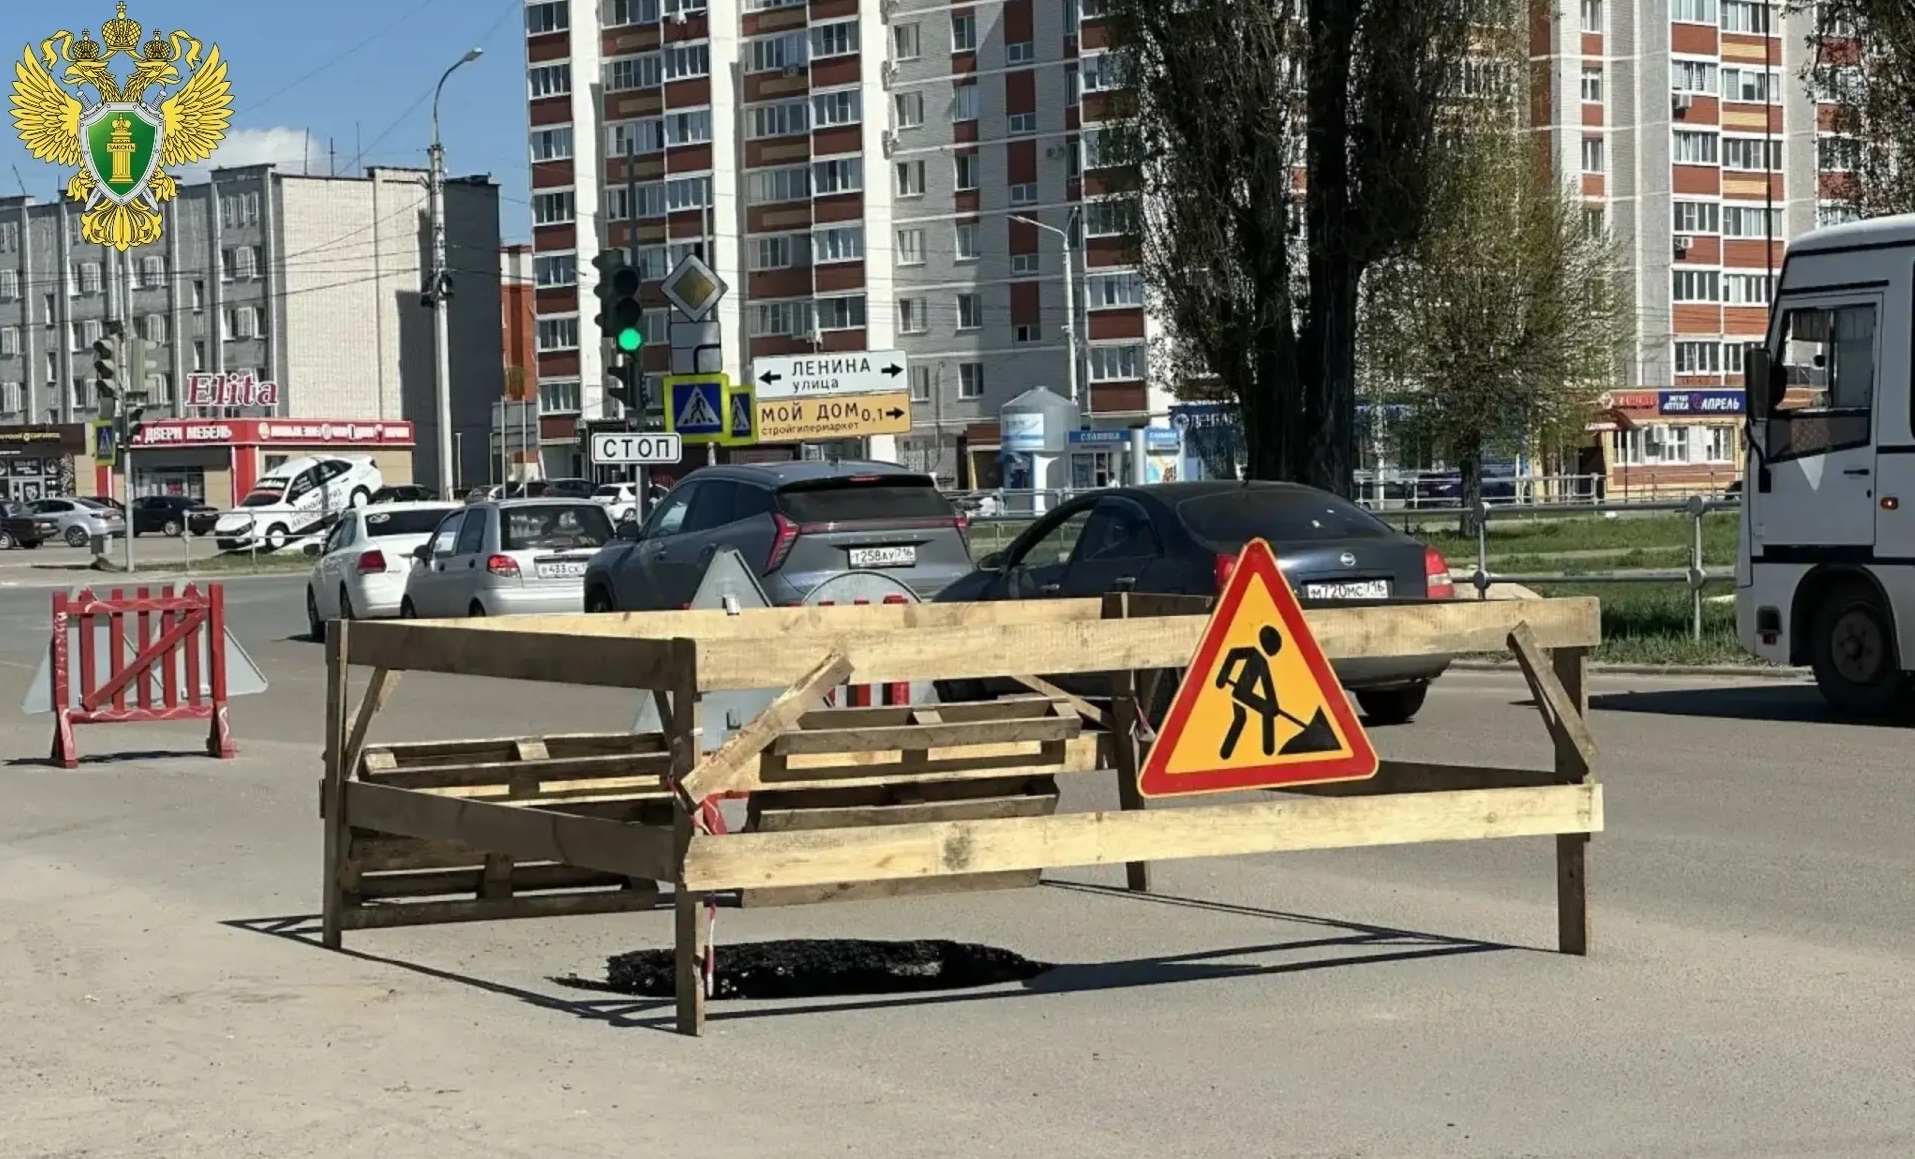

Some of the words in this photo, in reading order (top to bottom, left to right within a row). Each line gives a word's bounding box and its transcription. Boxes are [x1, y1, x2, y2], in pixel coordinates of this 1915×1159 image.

[792, 357, 871, 376] ЛЕНИНА
[186, 373, 279, 406] Elita
[793, 378, 839, 393] улица
[761, 403, 803, 422] МОЙ
[817, 402, 859, 421] ДОМ
[861, 408, 883, 423] 0,1
[1700, 397, 1740, 411] АПРЕЛЬ
[144, 426, 183, 444] ДВЕРИ
[186, 425, 233, 440] МЕБЕЛЬ
[761, 421, 860, 436] стройгипермаркет
[603, 439, 669, 458] СТОП
